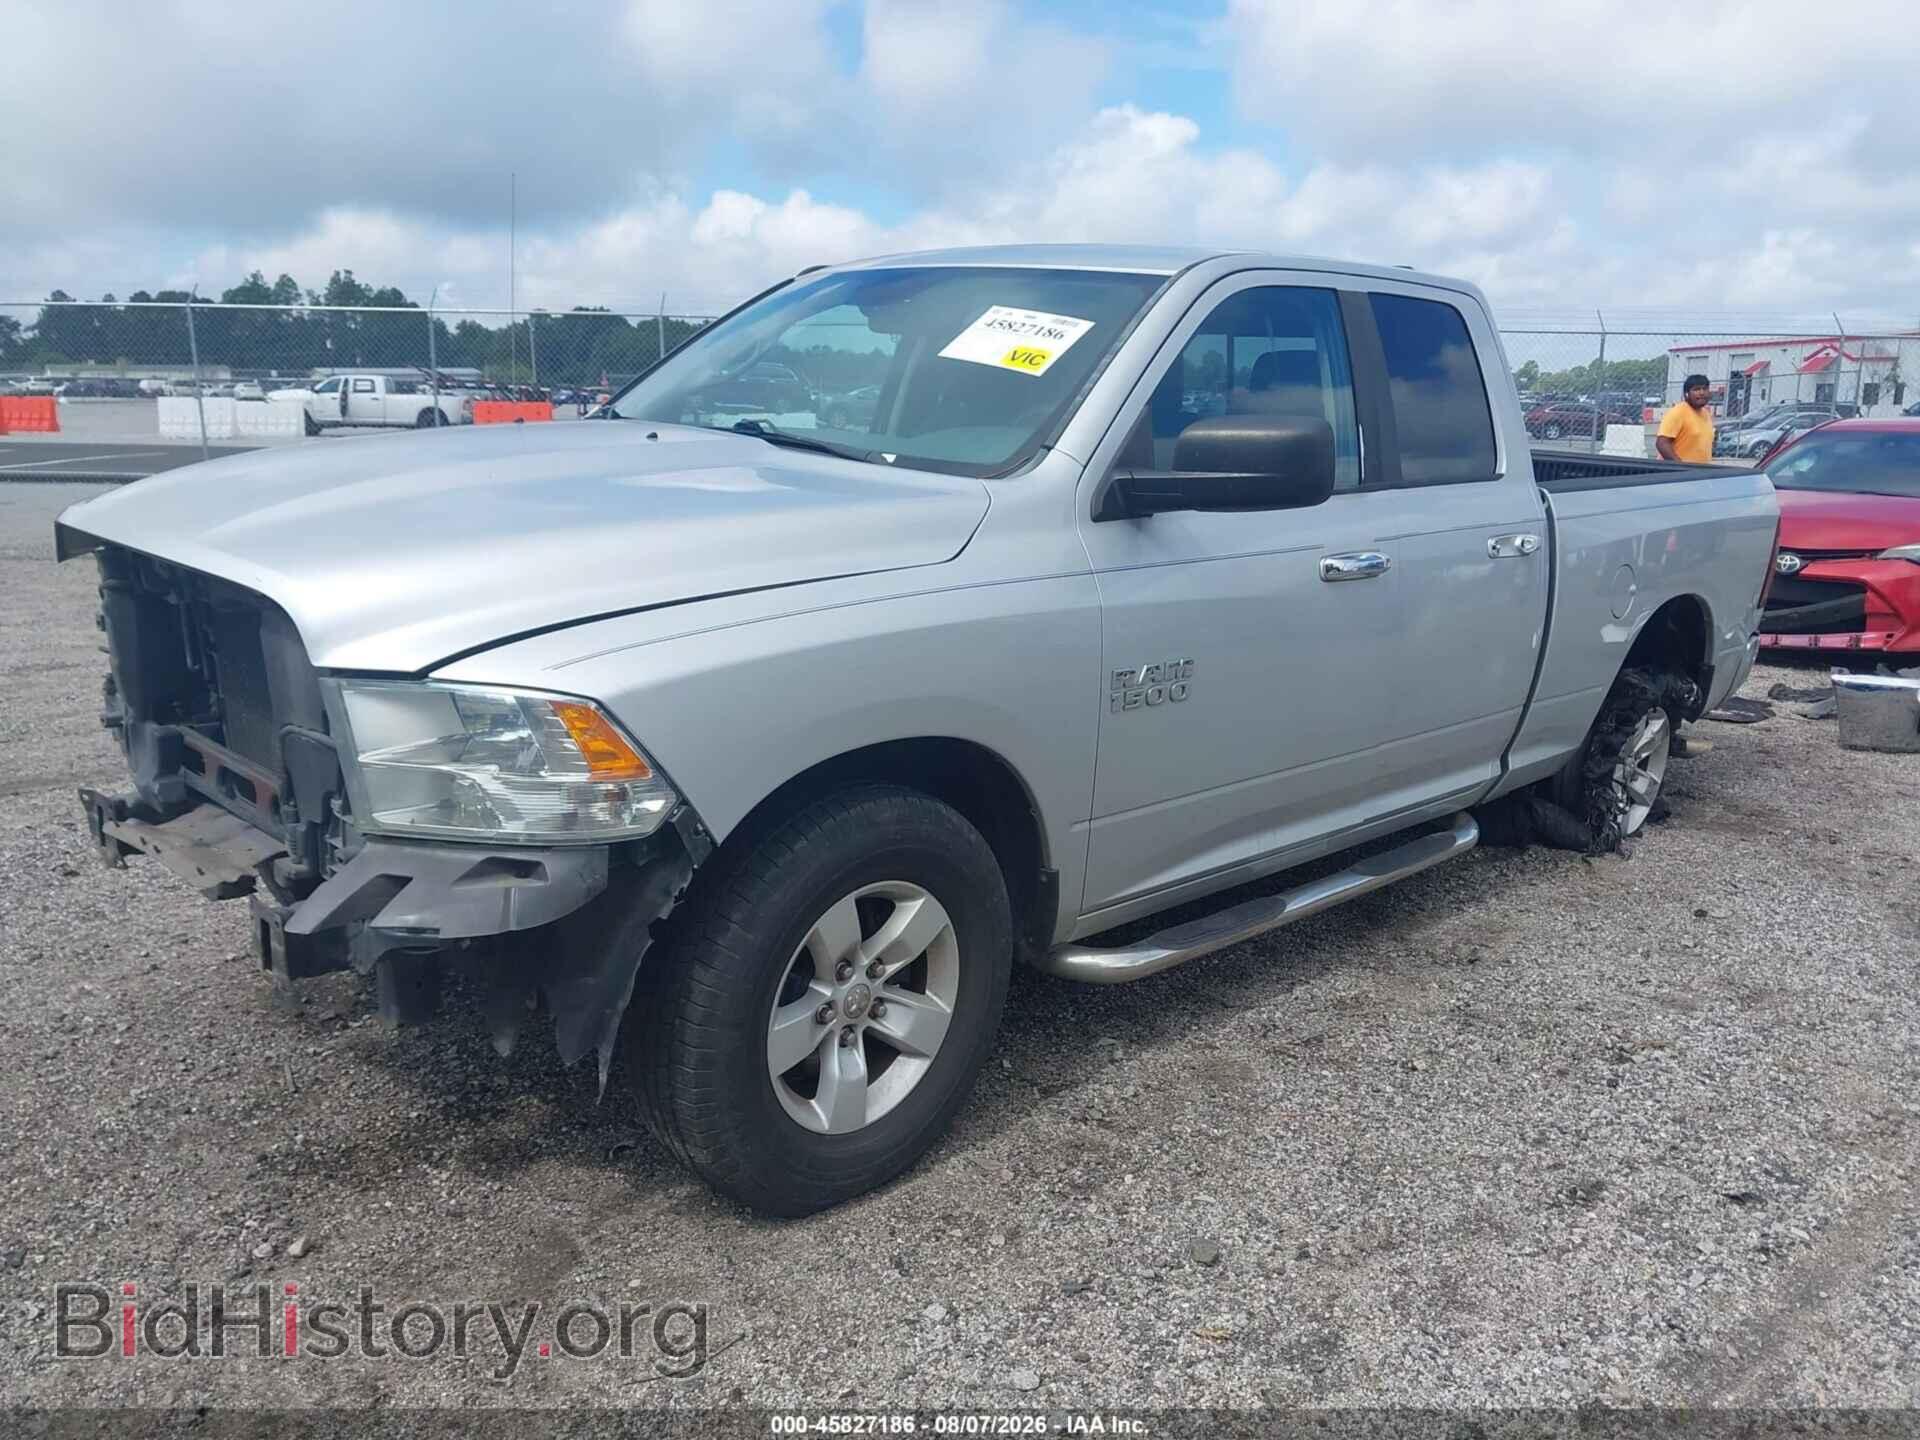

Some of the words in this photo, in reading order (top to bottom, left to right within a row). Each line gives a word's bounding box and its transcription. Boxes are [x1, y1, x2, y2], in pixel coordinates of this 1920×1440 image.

[984, 317, 1065, 341] 45827186
[1010, 349, 1047, 367] VIC
[1111, 658, 1194, 690] RAM
[1111, 681, 1191, 713] 1500
